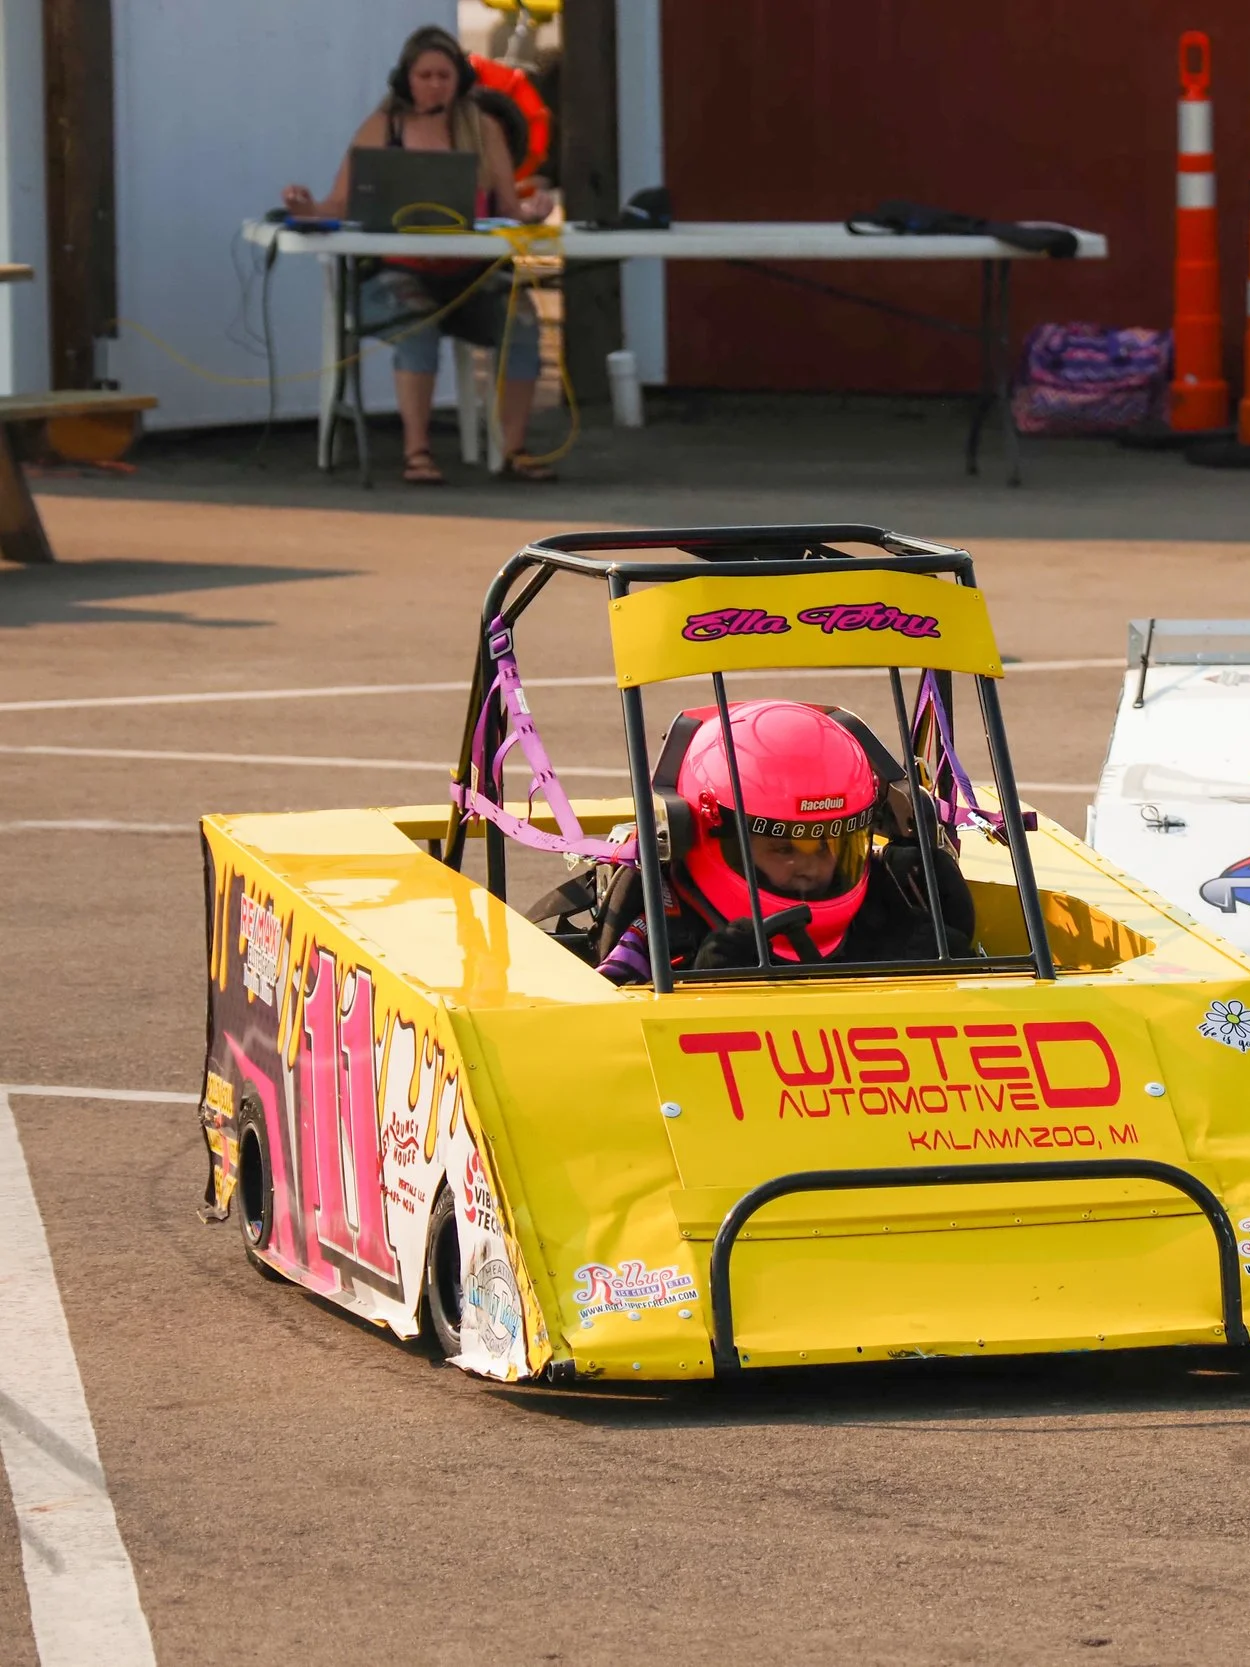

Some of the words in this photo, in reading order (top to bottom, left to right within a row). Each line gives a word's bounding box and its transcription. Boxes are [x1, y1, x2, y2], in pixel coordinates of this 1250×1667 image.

[681, 607, 791, 641] Ella
[798, 602, 941, 639] Terry
[801, 797, 844, 812] RaceQuip
[241, 896, 279, 957] RE/MAX
[1198, 1022, 1217, 1036] life
[1222, 1035, 1231, 1044] is
[679, 1020, 1122, 1121] TWISTED
[304, 946, 402, 1288] 11
[779, 1082, 1041, 1119] AUTOMOTIVE
[908, 1124, 1103, 1151] KALAMAZOO,
[1107, 1124, 1139, 1145] MI
[576, 1262, 674, 1305] Rollup
